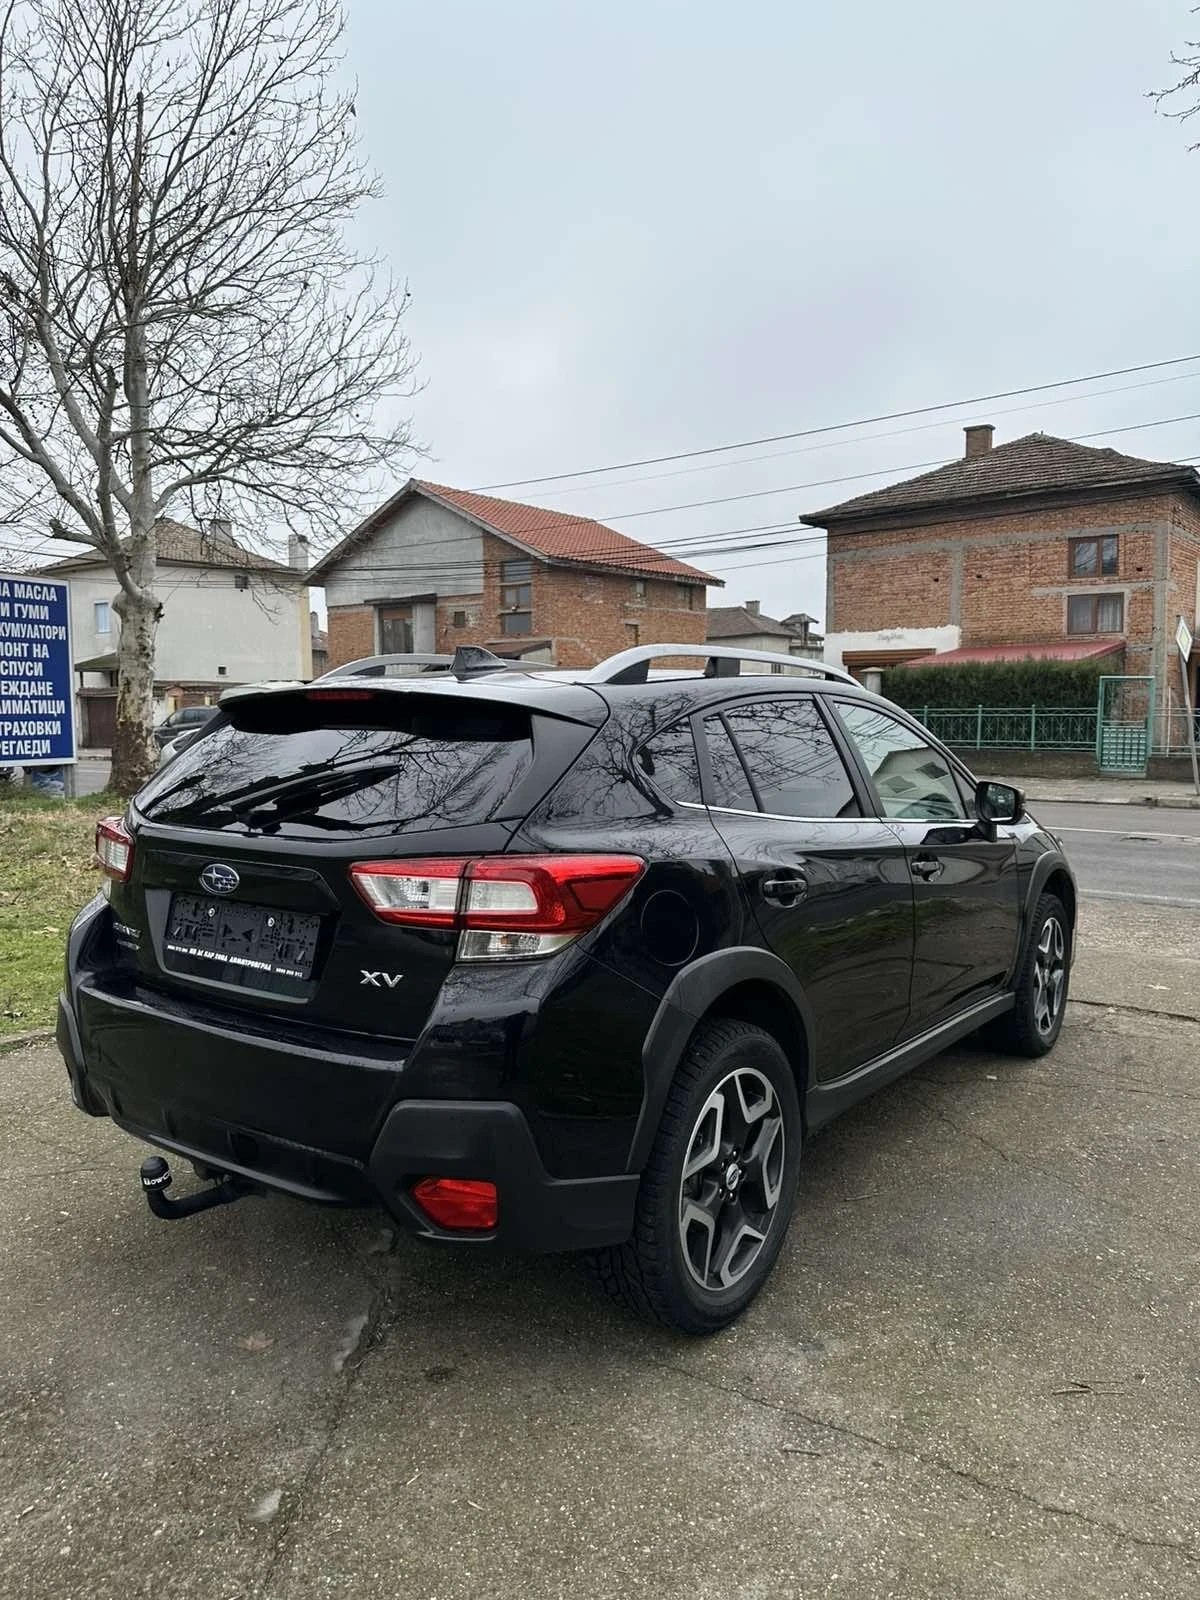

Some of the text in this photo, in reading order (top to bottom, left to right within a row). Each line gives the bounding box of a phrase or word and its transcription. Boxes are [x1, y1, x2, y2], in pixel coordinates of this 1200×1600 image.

[0, 582, 57, 601] А МАСЛА
[14, 603, 49, 621] ГУМИ
[32, 643, 50, 659] НА
[0, 660, 44, 677] СПУСИ
[1, 680, 54, 699] ЕЖДАНЕ
[0, 739, 51, 757] ЕГЛЕДИ
[360, 969, 404, 988] XV
